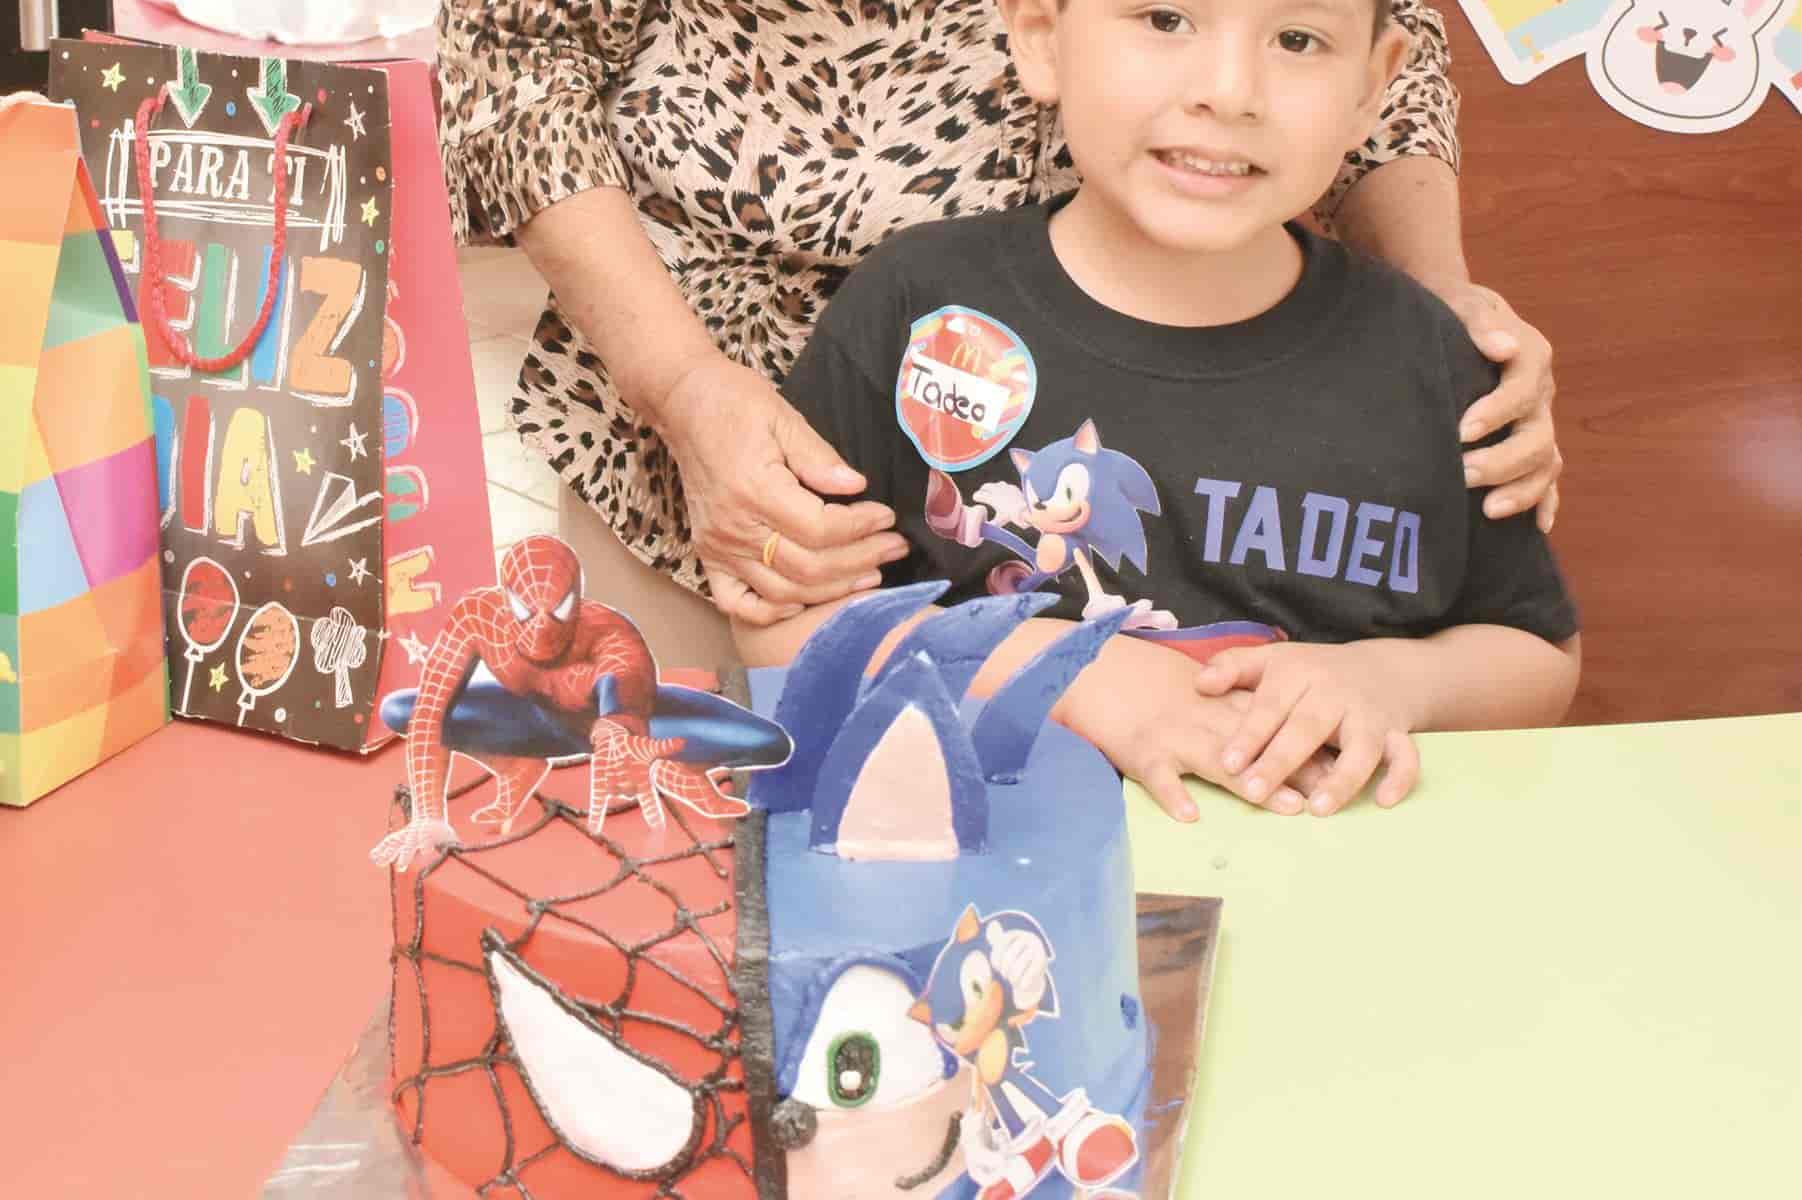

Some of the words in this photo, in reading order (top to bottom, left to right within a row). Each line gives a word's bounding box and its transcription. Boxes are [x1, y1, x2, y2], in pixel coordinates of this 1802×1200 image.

[149, 140, 251, 200] PARA
[111, 230, 365, 407] ELIZ
[911, 362, 985, 422] Tadeo
[1194, 477, 1421, 594] TADEO
